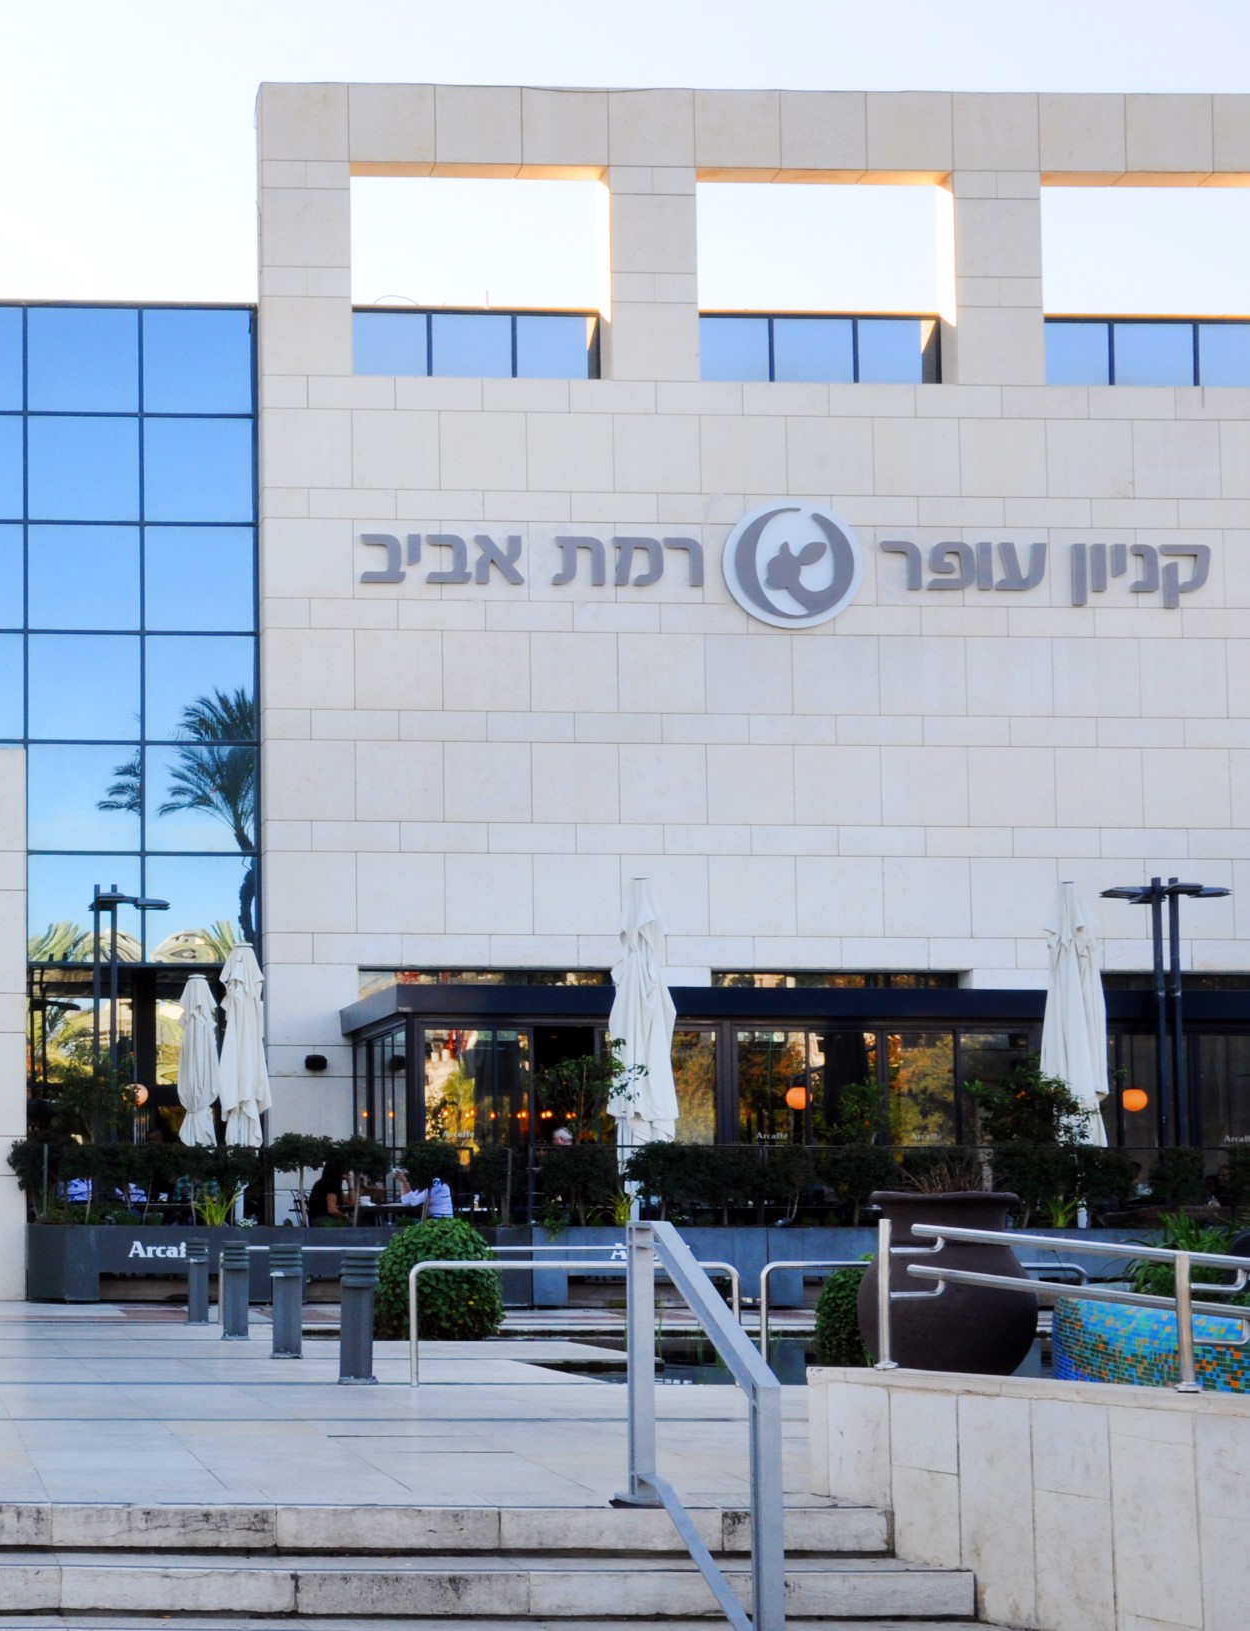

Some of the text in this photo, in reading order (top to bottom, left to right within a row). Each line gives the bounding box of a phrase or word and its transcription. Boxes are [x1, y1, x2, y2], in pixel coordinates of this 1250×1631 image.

[359, 534, 1212, 610] קניון עופר רמת אביב
[128, 1240, 188, 1259] Arcaf
